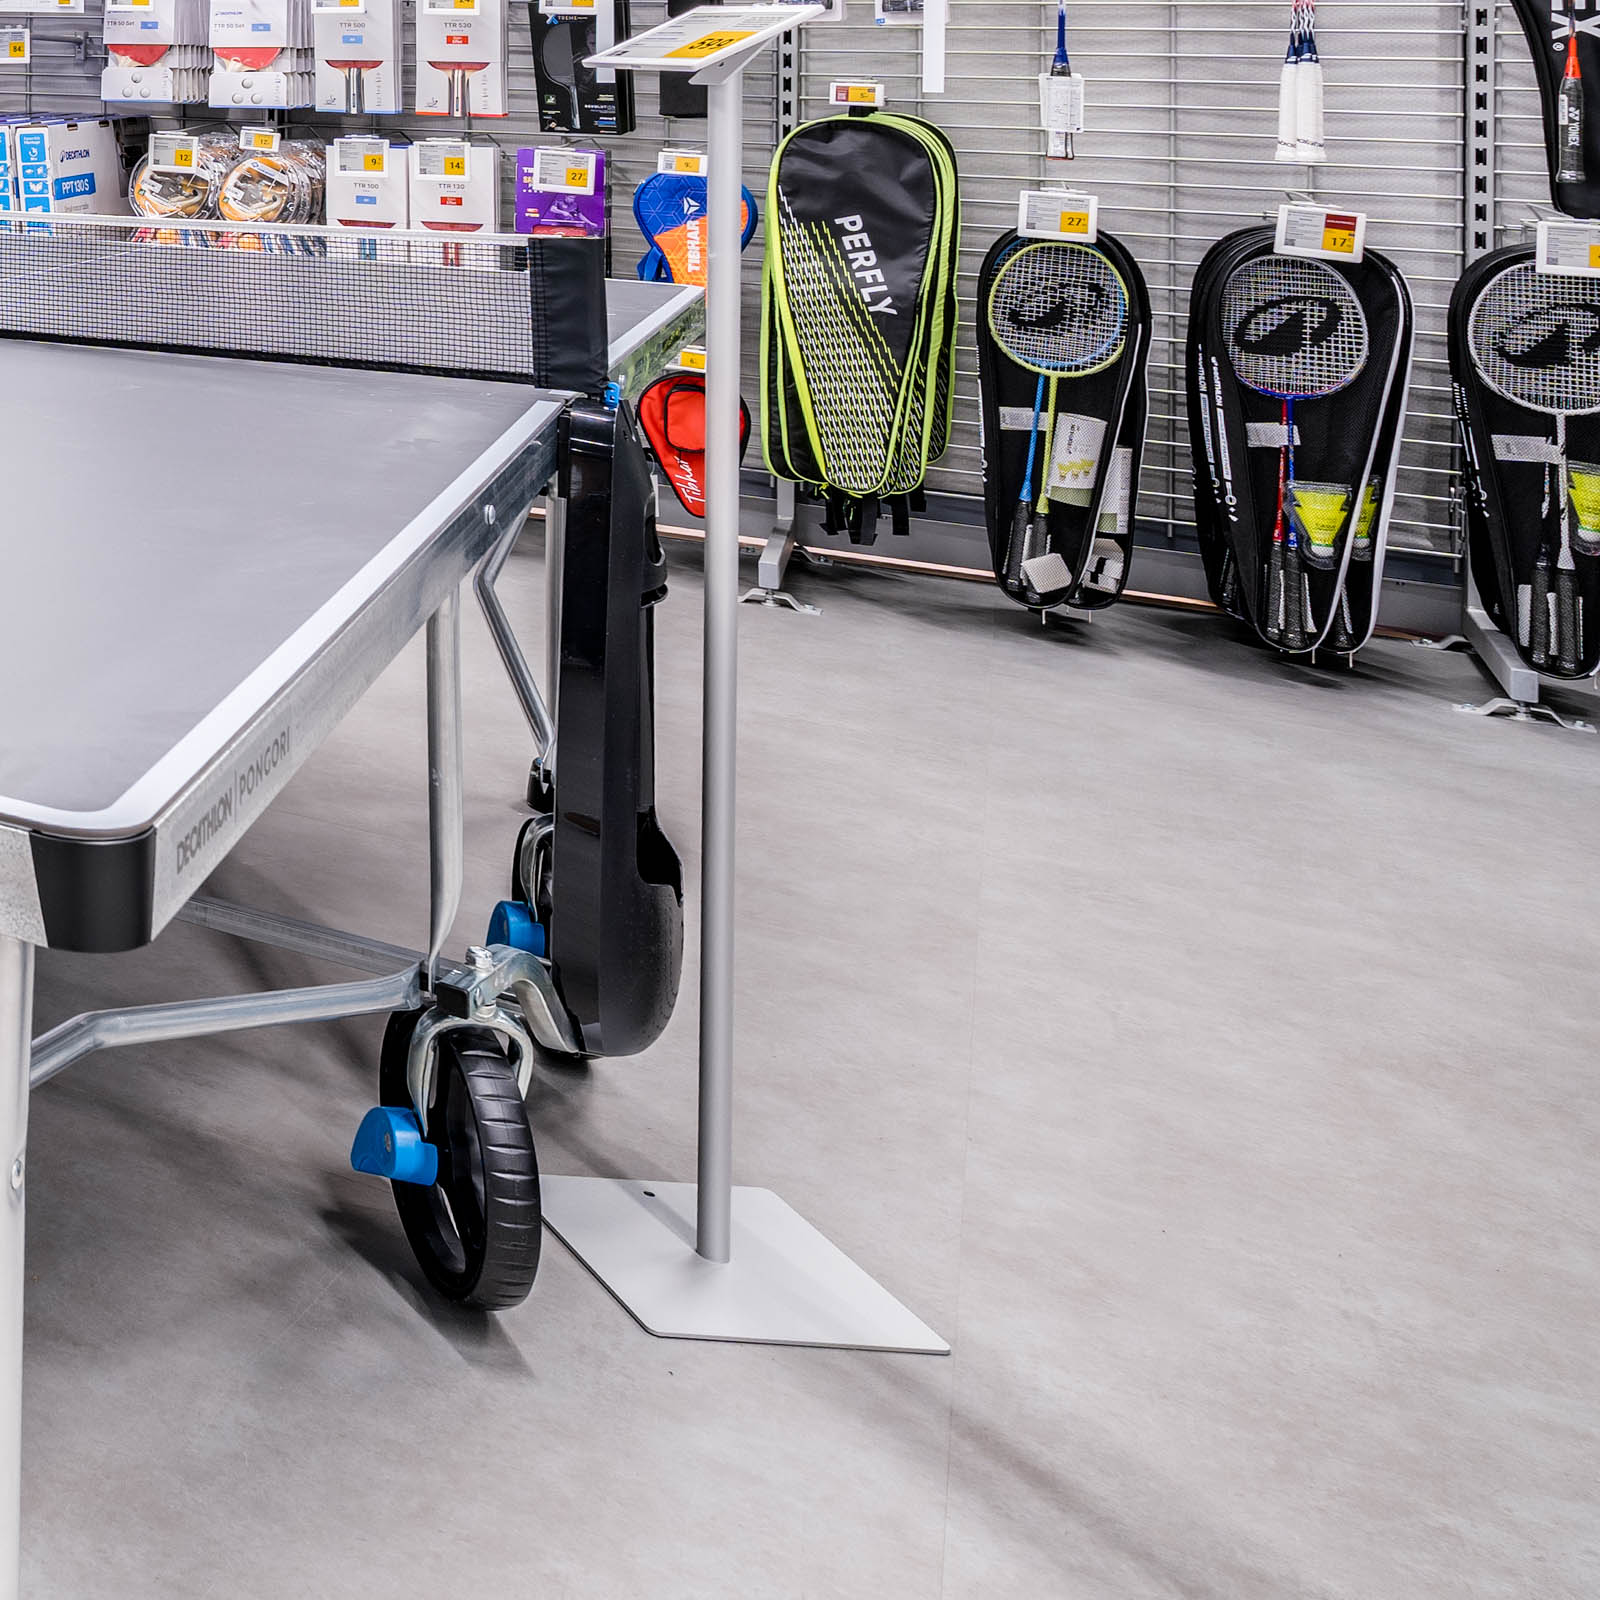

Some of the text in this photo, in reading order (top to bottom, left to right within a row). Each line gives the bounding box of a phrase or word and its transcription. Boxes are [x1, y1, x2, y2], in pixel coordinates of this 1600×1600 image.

[66, 149, 90, 160] DECATHLON
[1568, 123, 1580, 148] YONEX
[687, 216, 702, 274] TIBHAR
[833, 214, 899, 317] PERFLY
[240, 726, 290, 805] PONGORI
[177, 787, 233, 875] DECATHLON
